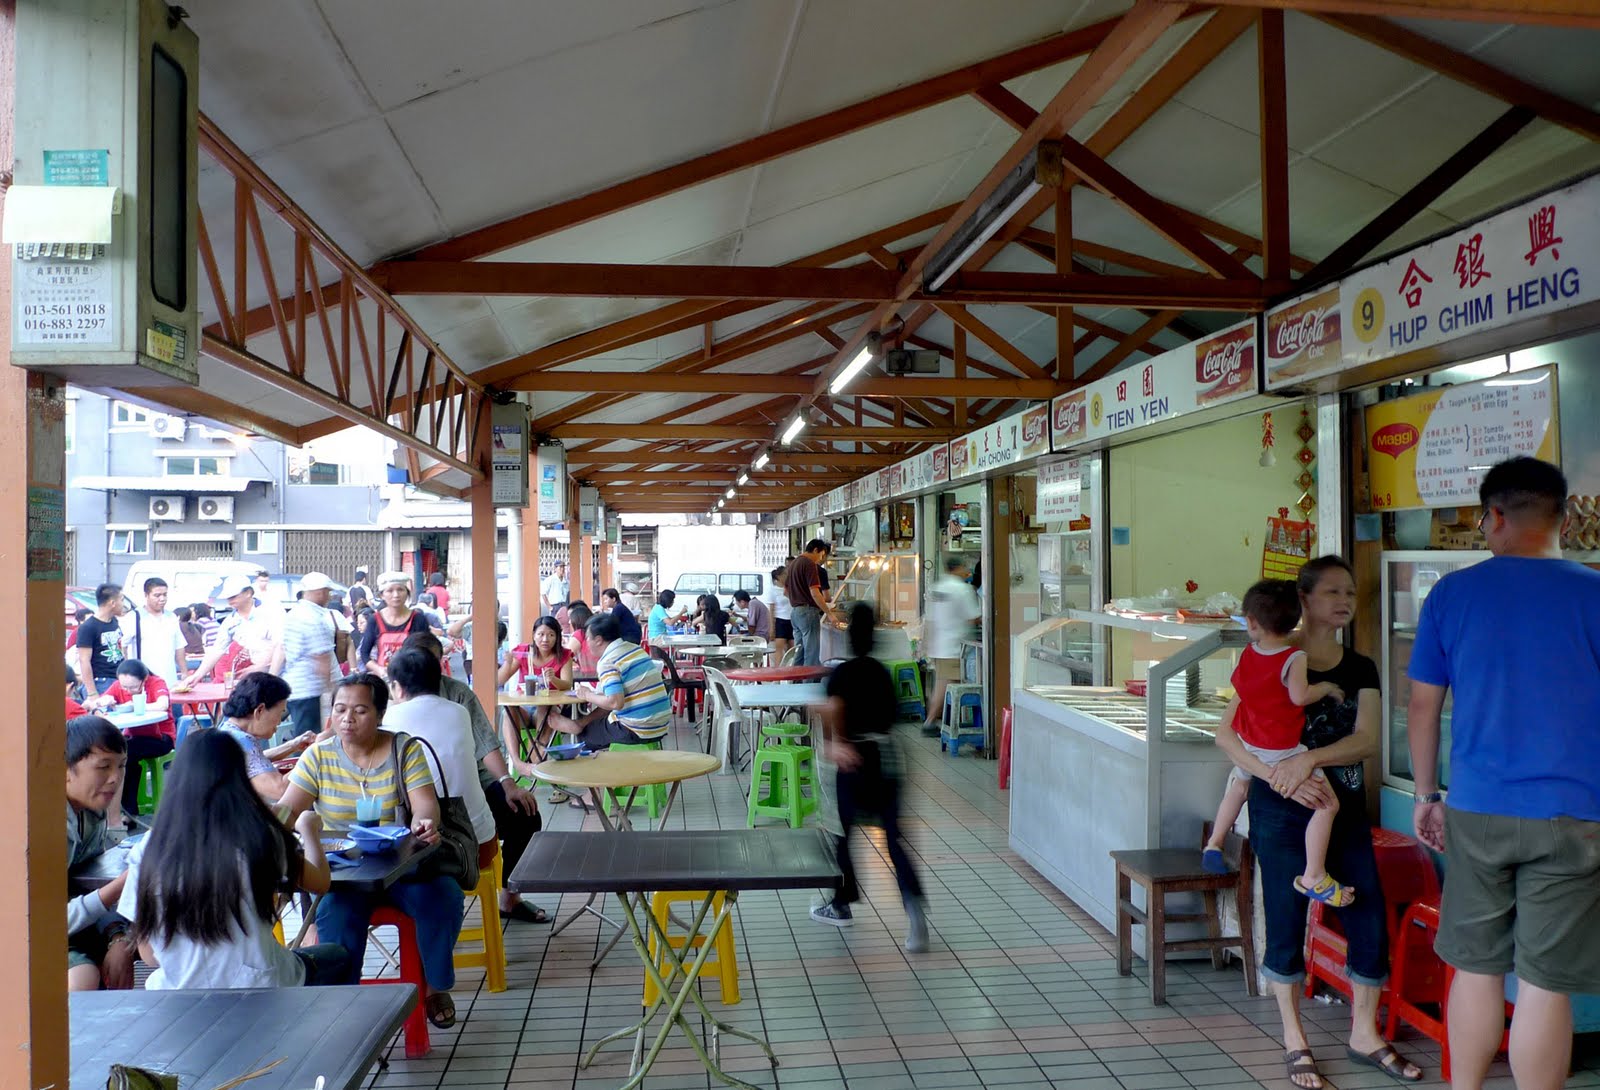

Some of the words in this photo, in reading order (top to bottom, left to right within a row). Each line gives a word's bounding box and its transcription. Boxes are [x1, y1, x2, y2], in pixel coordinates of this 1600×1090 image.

[24, 304, 72, 315] 013-561
[76, 304, 106, 315] 0818
[1362, 301, 1375, 330] 9
[1390, 316, 1428, 348] HUP
[1438, 294, 1493, 333] GHIM
[1507, 267, 1580, 314] HENG
[24, 319, 73, 330] 016-883
[77, 318, 106, 330] 2297
[1094, 401, 1100, 420] 8
[1106, 408, 1134, 431] TIEN
[1140, 396, 1169, 421] YEN
[1377, 430, 1413, 447] Maggi
[978, 455, 987, 468] AH
[988, 448, 1011, 465] CHONG
[1373, 493, 1385, 507] No.
[1386, 493, 1392, 506] 9
